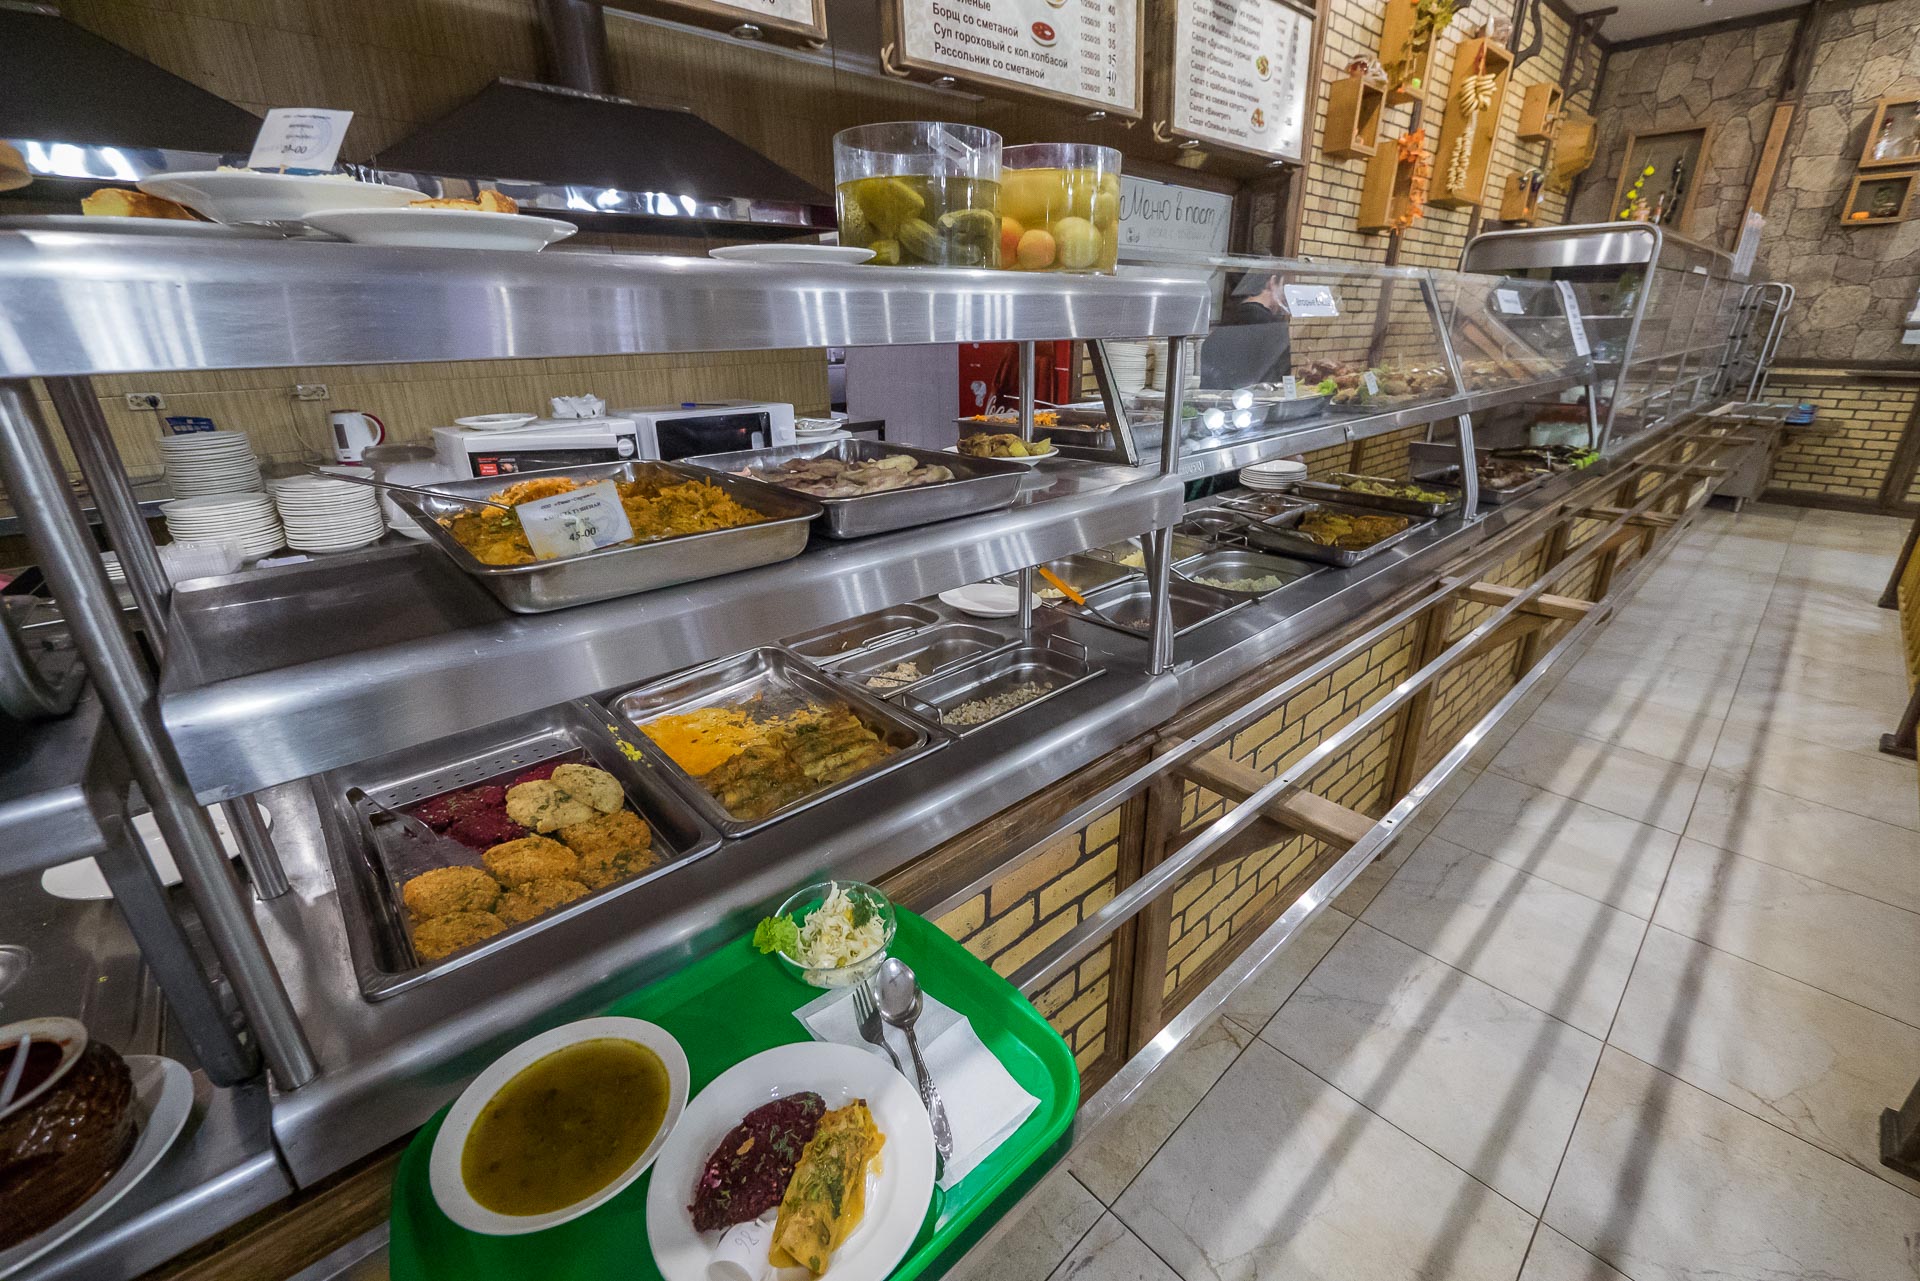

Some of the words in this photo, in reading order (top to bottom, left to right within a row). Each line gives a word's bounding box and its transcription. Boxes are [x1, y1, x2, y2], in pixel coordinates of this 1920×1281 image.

[1192, 1, 1207, 15] Салат
[932, 2, 961, 23] Борщ
[963, 14, 974, 25] со
[976, 17, 1019, 38] сметаной
[1192, 16, 1207, 29] Салат
[1108, 21, 1116, 33] 35
[1108, 38, 1116, 49] 35
[1191, 31, 1206, 44] Салат
[933, 23, 953, 39] Суп
[955, 30, 1005, 52] гороховый
[1007, 46, 1012, 54] с
[1014, 46, 1068, 69] коп.колбасой
[1106, 70, 1116, 84] 40
[1191, 46, 1206, 58] Салат
[934, 42, 990, 66] Рассольник
[993, 60, 1003, 70] со
[1005, 62, 1045, 79] сметаной
[1108, 86, 1115, 97] 30
[1190, 60, 1205, 72] Салат
[1190, 73, 1204, 86] Салат
[1189, 88, 1204, 99] Салат
[1189, 101, 1204, 112] Салат
[1189, 115, 1203, 126] Салат
[1119, 186, 1171, 221] Меню
[569, 527, 597, 541] 45-00
